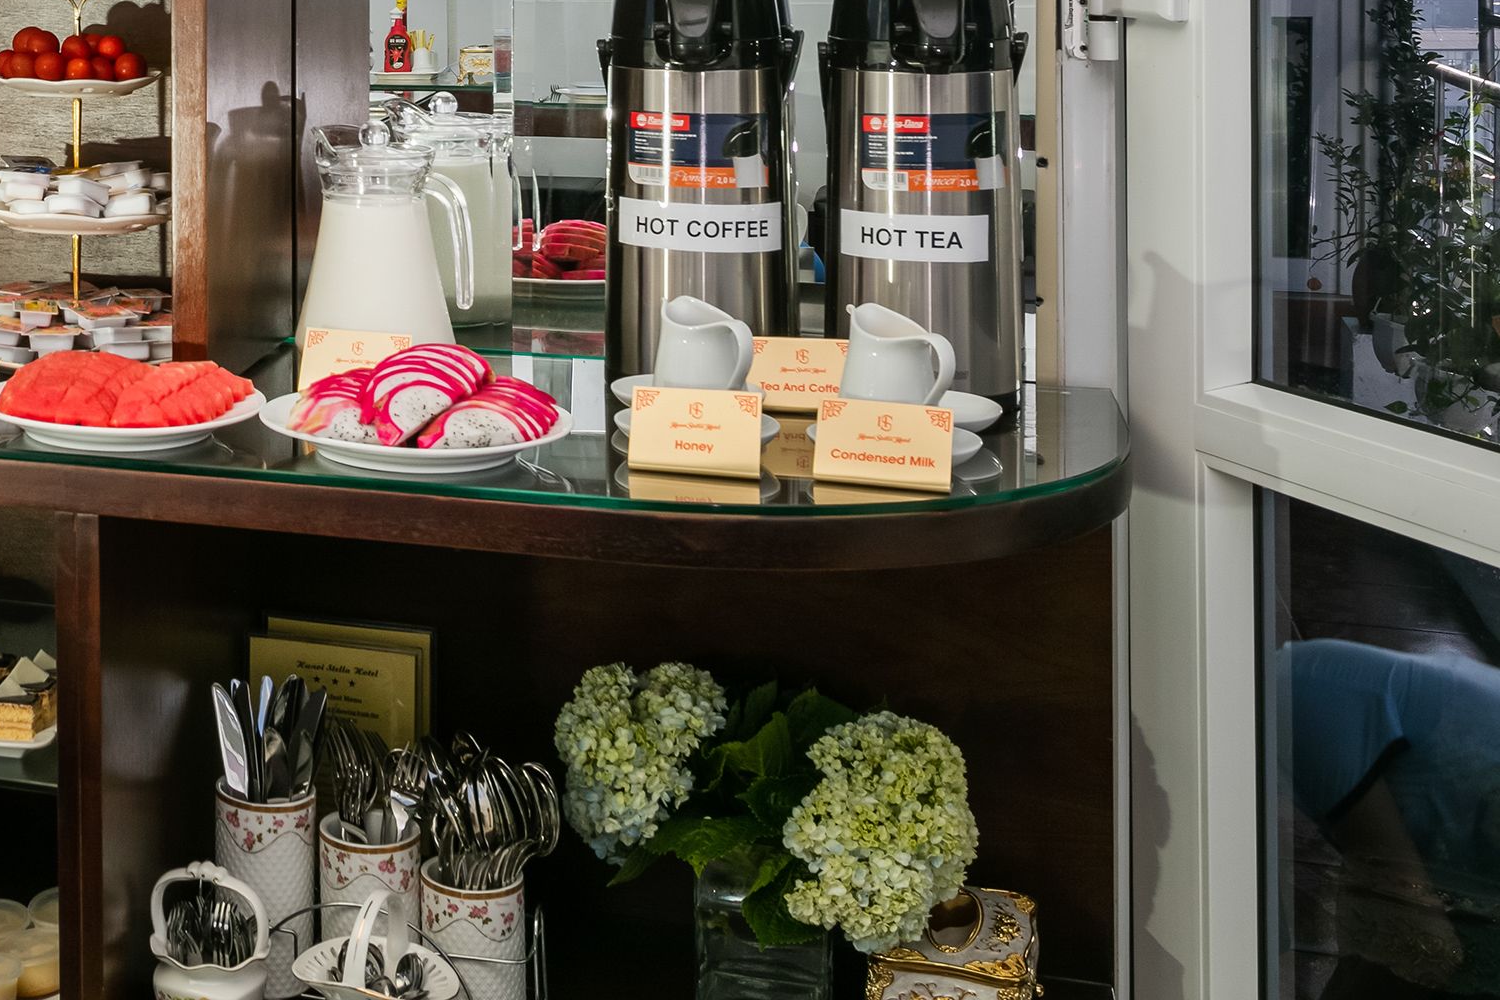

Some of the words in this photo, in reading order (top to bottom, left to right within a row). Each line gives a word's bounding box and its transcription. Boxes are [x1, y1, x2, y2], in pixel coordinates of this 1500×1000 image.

[636, 216, 679, 236] HOT
[687, 220, 768, 238] COFFEE
[861, 226, 907, 247] HOT
[915, 230, 963, 249] TEA
[760, 381, 780, 391] Tea
[784, 383, 805, 393] And
[809, 383, 840, 394] Coffe
[675, 440, 714, 454] Honey
[830, 449, 906, 465] Condensed
[910, 456, 936, 468] Milk
[296, 660, 324, 671] Hanoi
[354, 667, 379, 677] Hotel
